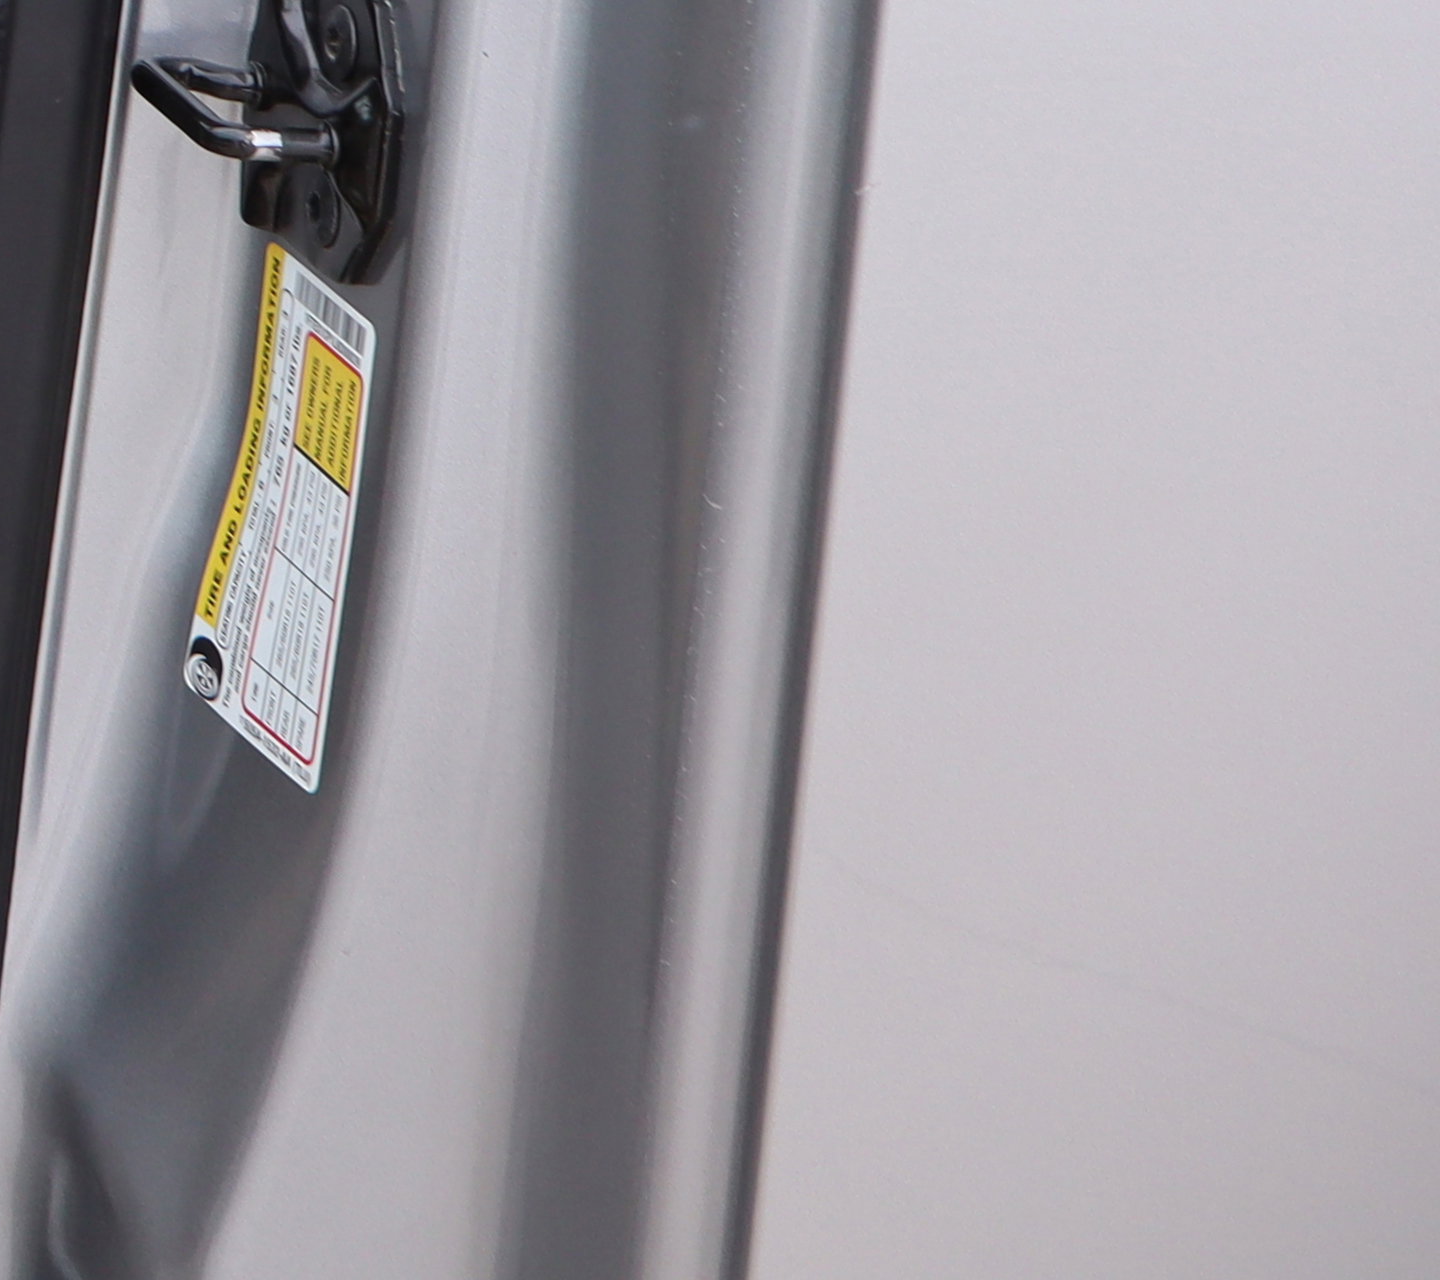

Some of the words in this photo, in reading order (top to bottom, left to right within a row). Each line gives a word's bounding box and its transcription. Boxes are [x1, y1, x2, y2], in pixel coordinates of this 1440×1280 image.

[300, 418, 312, 451] SEE
[305, 353, 321, 421] OWNERS
[312, 401, 328, 462] MANUAL
[320, 362, 333, 401] FOR
[325, 377, 345, 470] ADDITIONAL
[337, 377, 357, 485] INFORMATION
[203, 566, 223, 621] TIRE
[218, 515, 238, 566] AND
[232, 413, 262, 515] LOADING
[255, 253, 282, 412] INFORMATION
